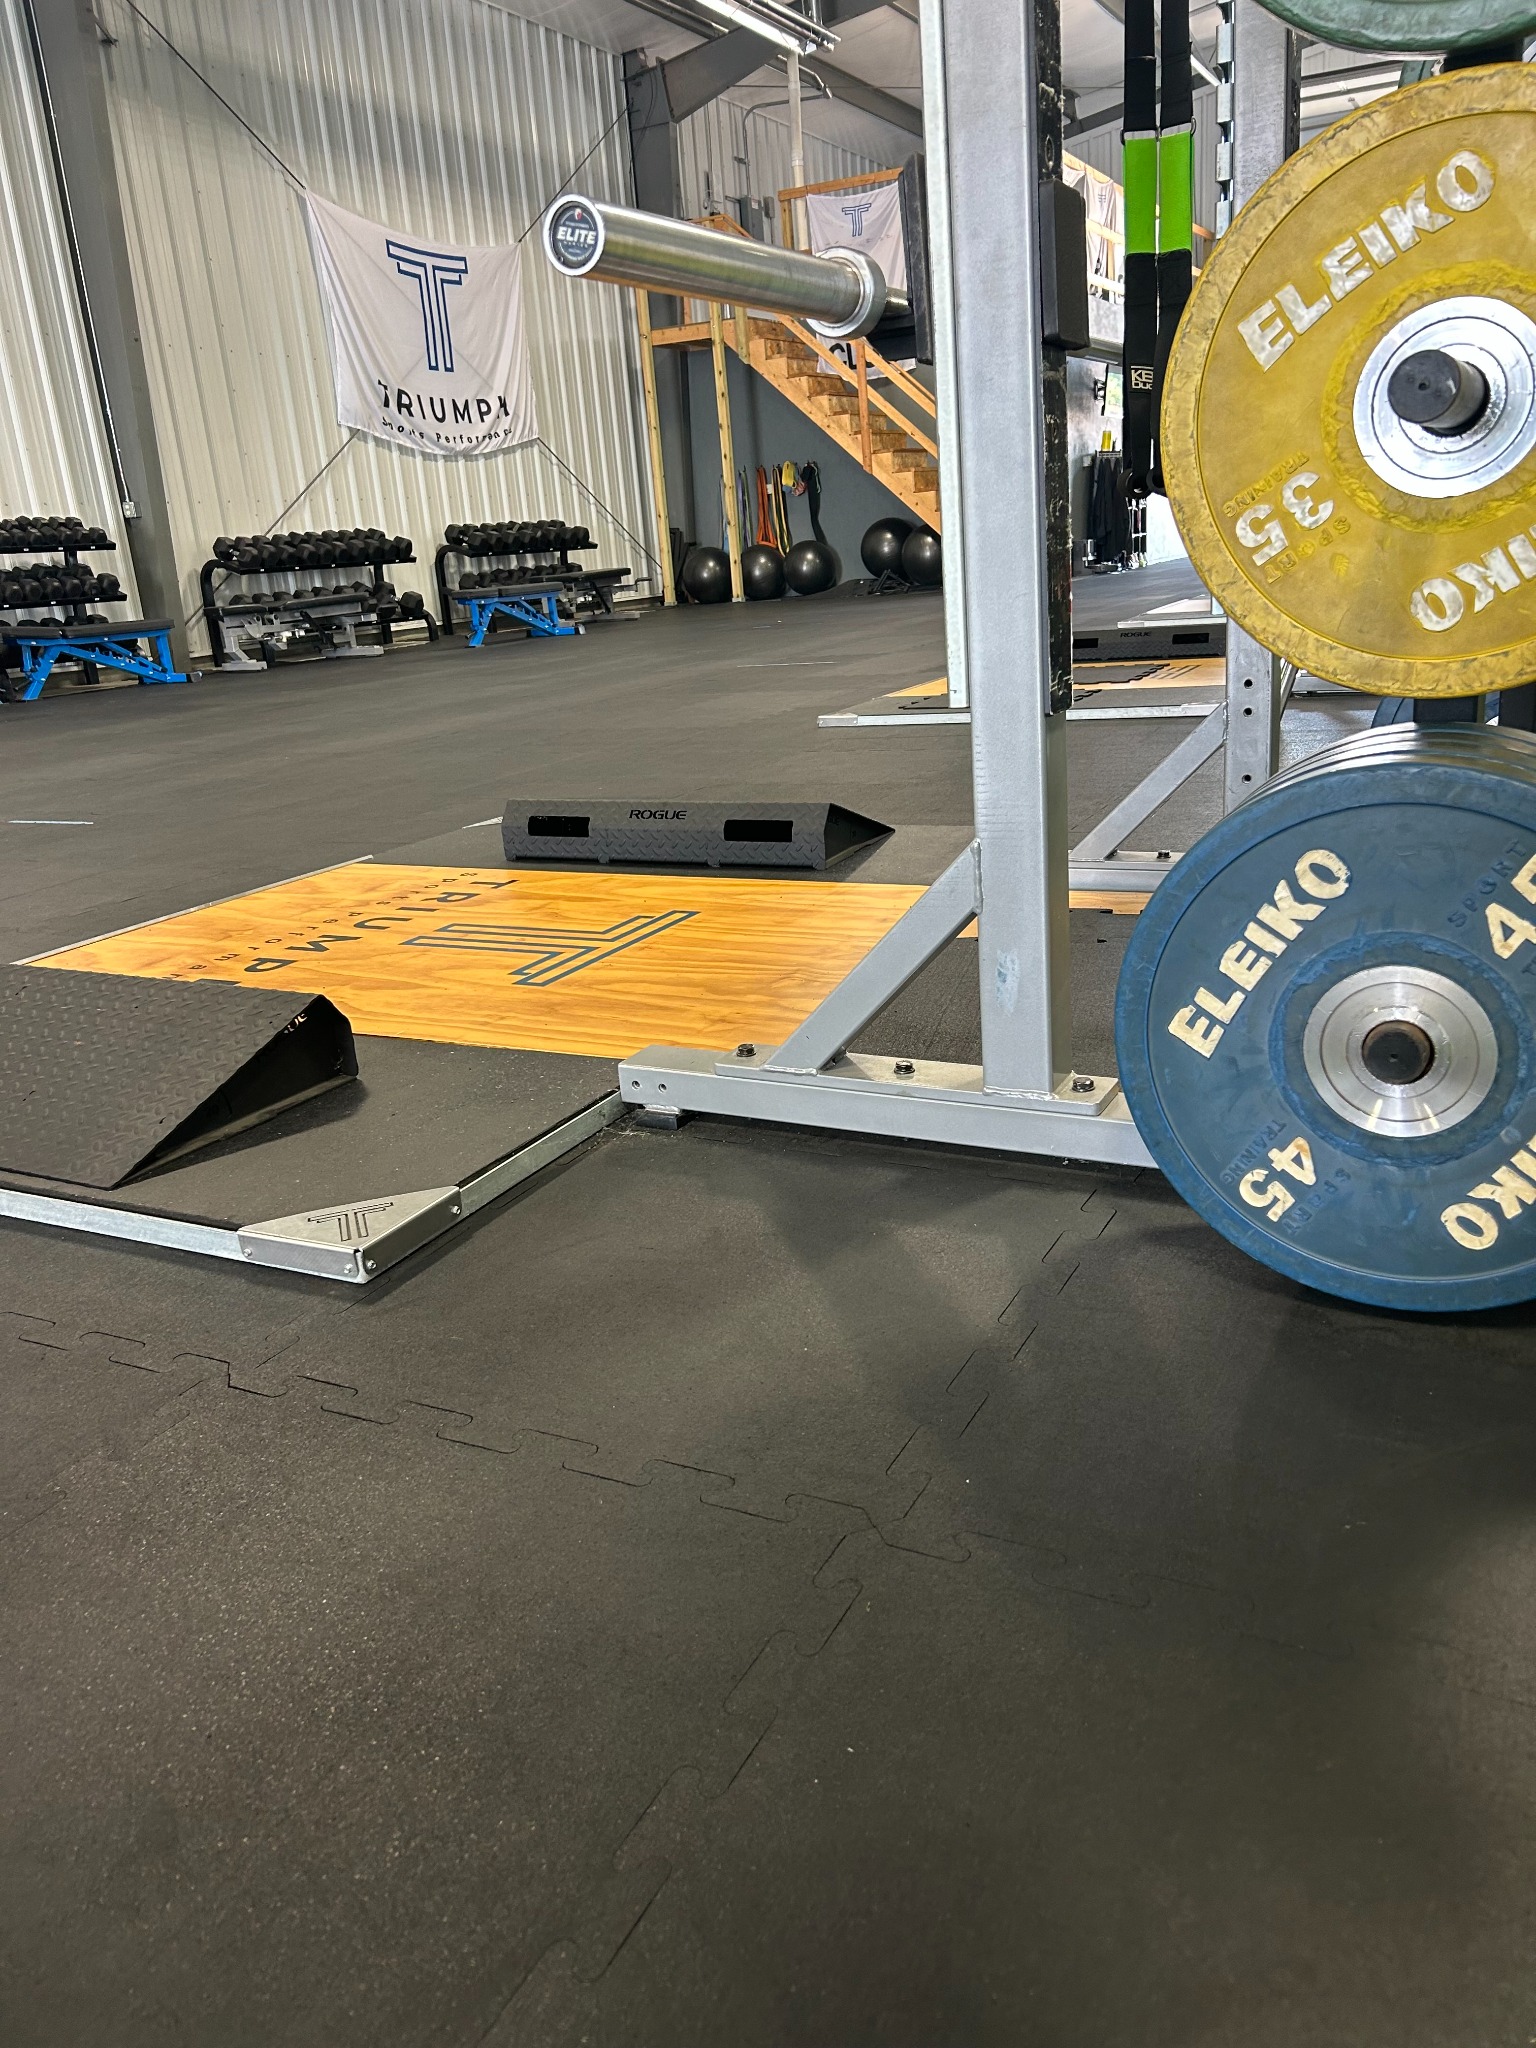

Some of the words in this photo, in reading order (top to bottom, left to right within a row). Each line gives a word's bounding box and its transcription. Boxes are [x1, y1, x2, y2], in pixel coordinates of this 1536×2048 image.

[557, 226, 597, 245] ELITE
[1237, 148, 1496, 372] ELEIKO
[377, 378, 511, 424] TRIUMPH
[1235, 471, 1334, 567] 35
[1263, 515, 1352, 584] SPORT
[628, 808, 688, 820] ROGUE
[1166, 848, 1352, 1060] ELEIKO
[1238, 1136, 1317, 1222] 45
